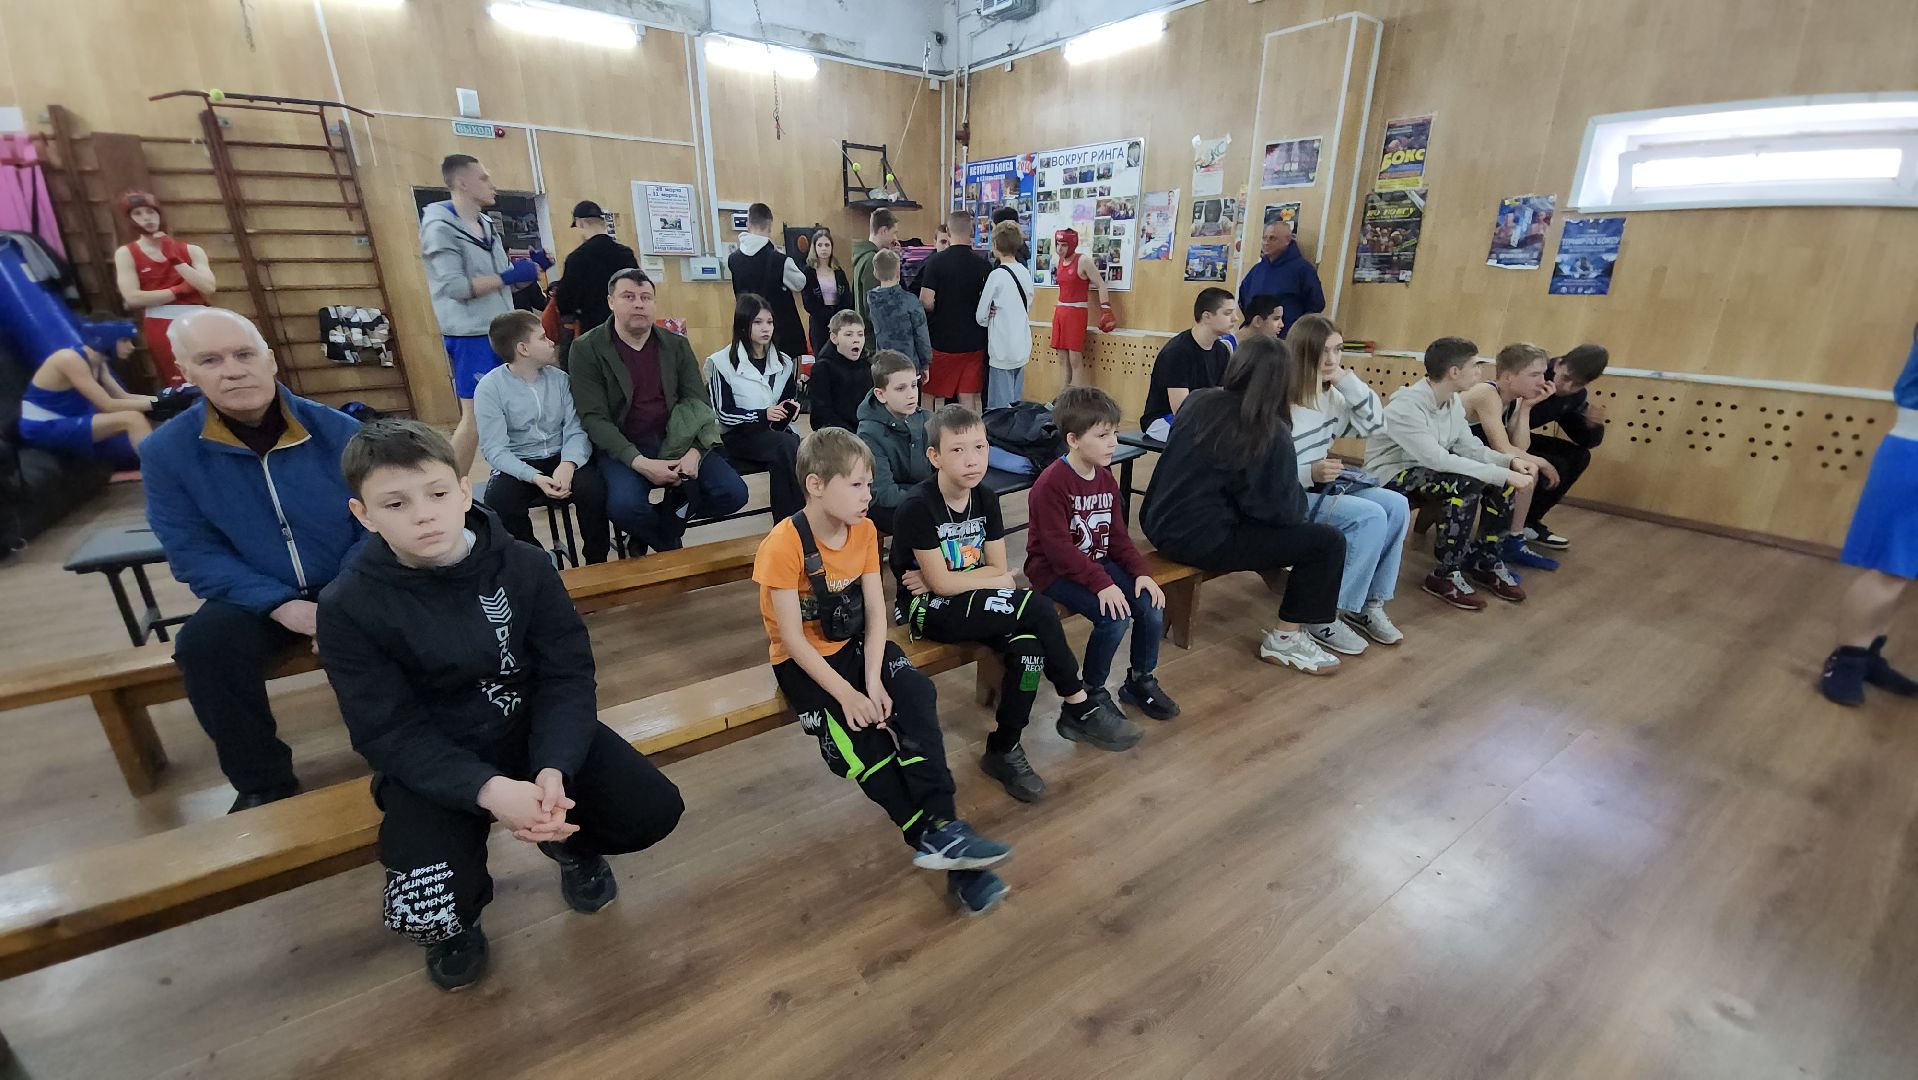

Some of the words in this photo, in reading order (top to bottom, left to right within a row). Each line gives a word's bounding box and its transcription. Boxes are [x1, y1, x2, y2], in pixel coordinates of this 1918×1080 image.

[456, 123, 492, 136] ВЫХОД
[1051, 152, 1089, 167] ВОКРУГ
[1091, 147, 1125, 162] РИНГА
[1380, 148, 1426, 173] БОКС
[1020, 655, 1040, 665] PALM
[410, 861, 449, 878] ABSENCE
[423, 883, 445, 897] AND
[414, 892, 456, 911] IMMENSE
